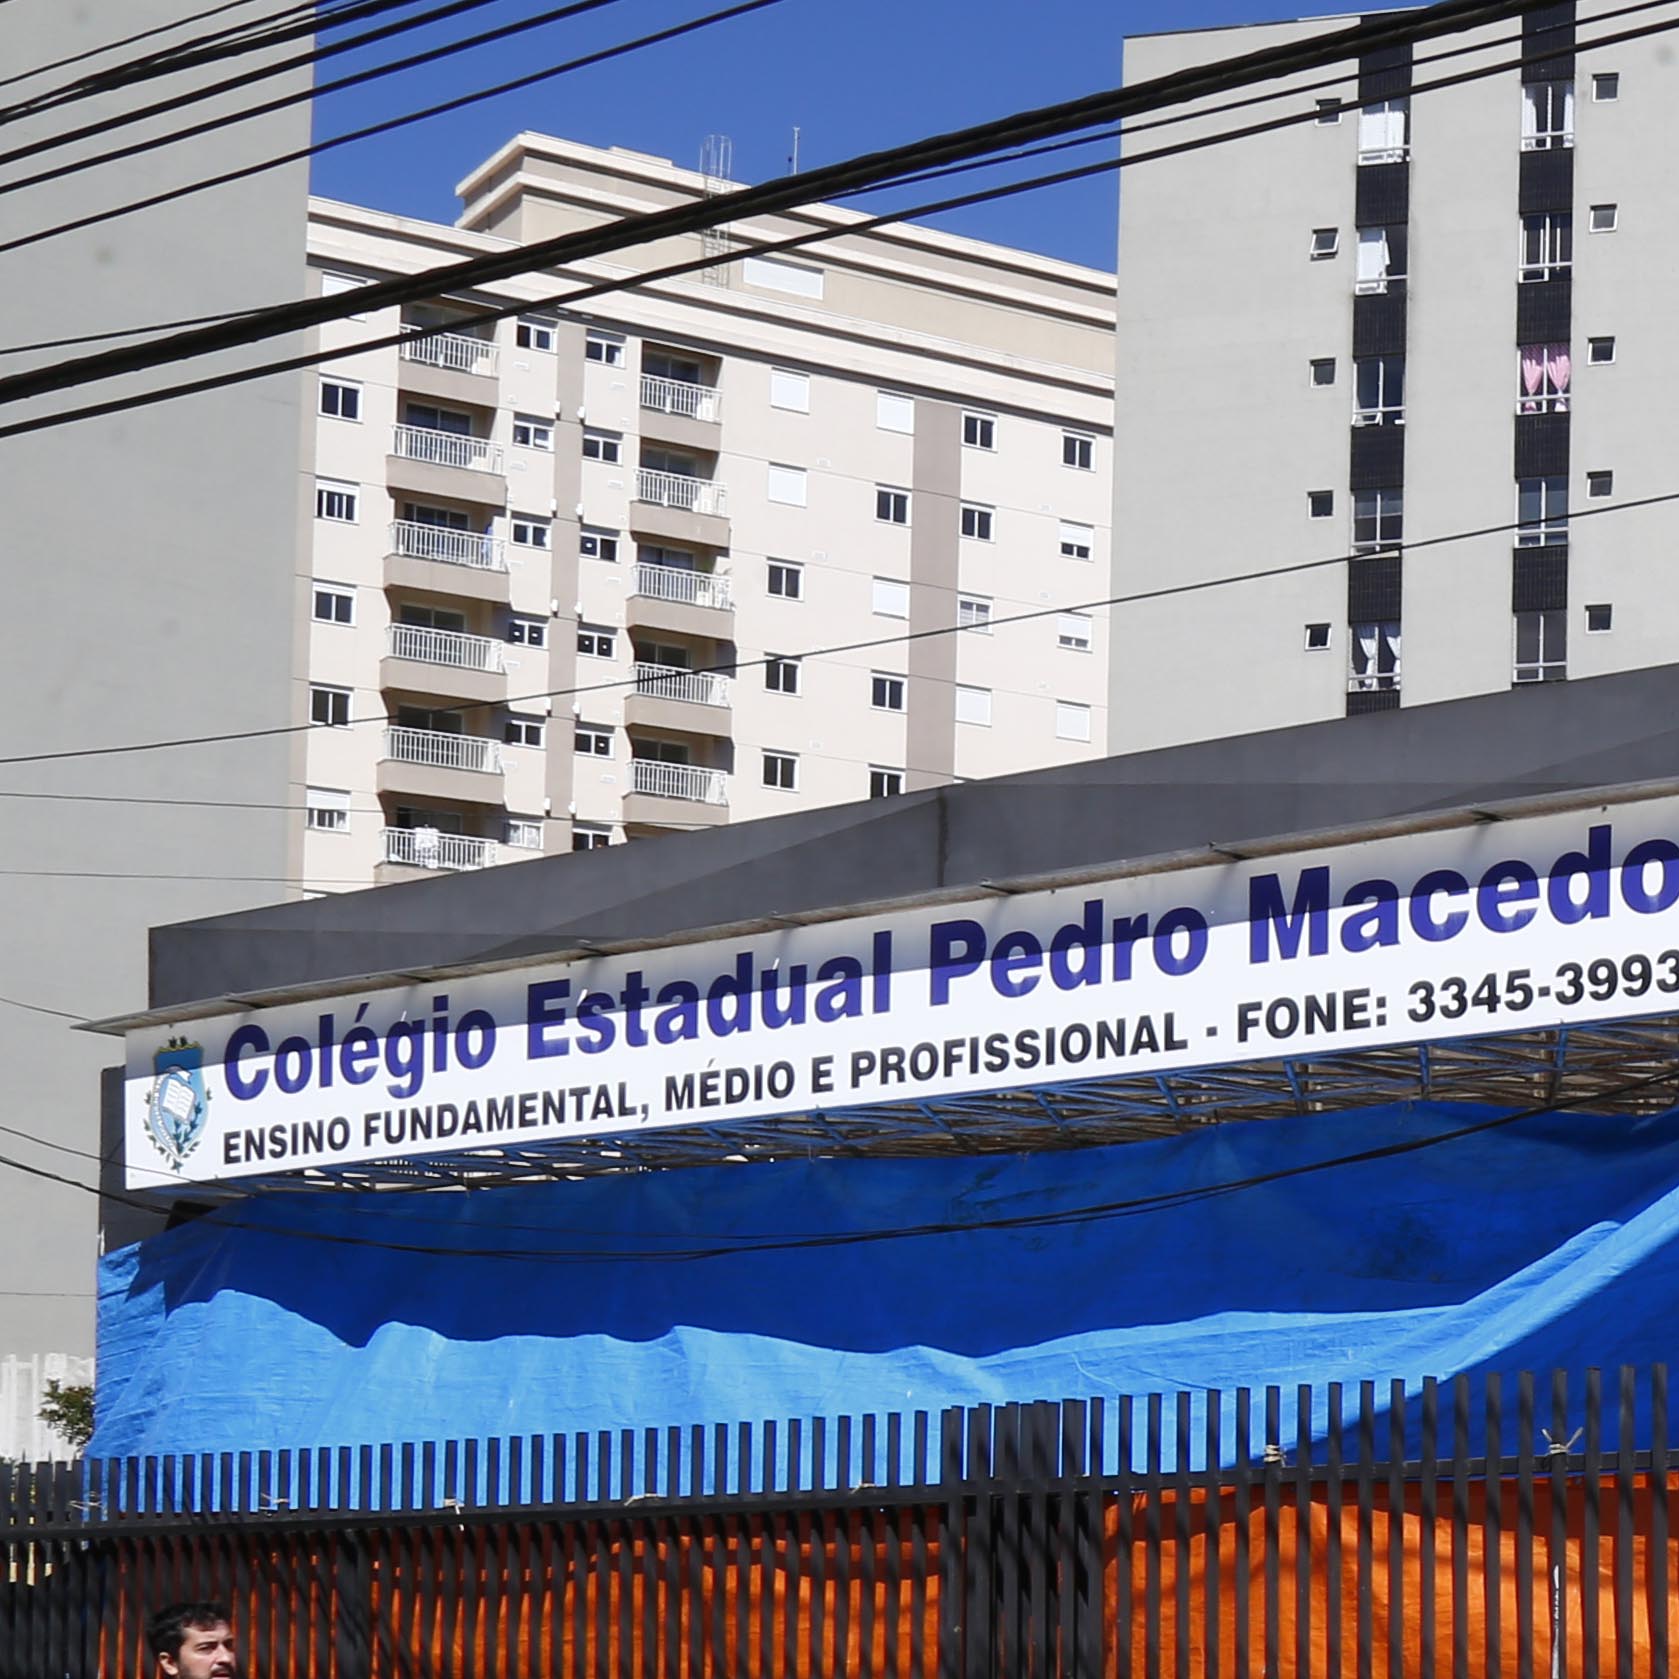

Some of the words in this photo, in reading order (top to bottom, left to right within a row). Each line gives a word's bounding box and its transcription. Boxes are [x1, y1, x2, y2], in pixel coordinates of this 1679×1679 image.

[223, 994, 497, 1100] Colégio
[526, 930, 892, 1061] Estadual
[929, 899, 1209, 1007] Pedro
[223, 1116, 351, 1166] ENSINO
[363, 1081, 650, 1147] FUNDAMENTAL,
[664, 1059, 795, 1112] MÉDIO
[811, 1055, 834, 1094] E
[850, 1012, 1189, 1089] PROFISSIONAL
[1237, 987, 1388, 1043] FONE:
